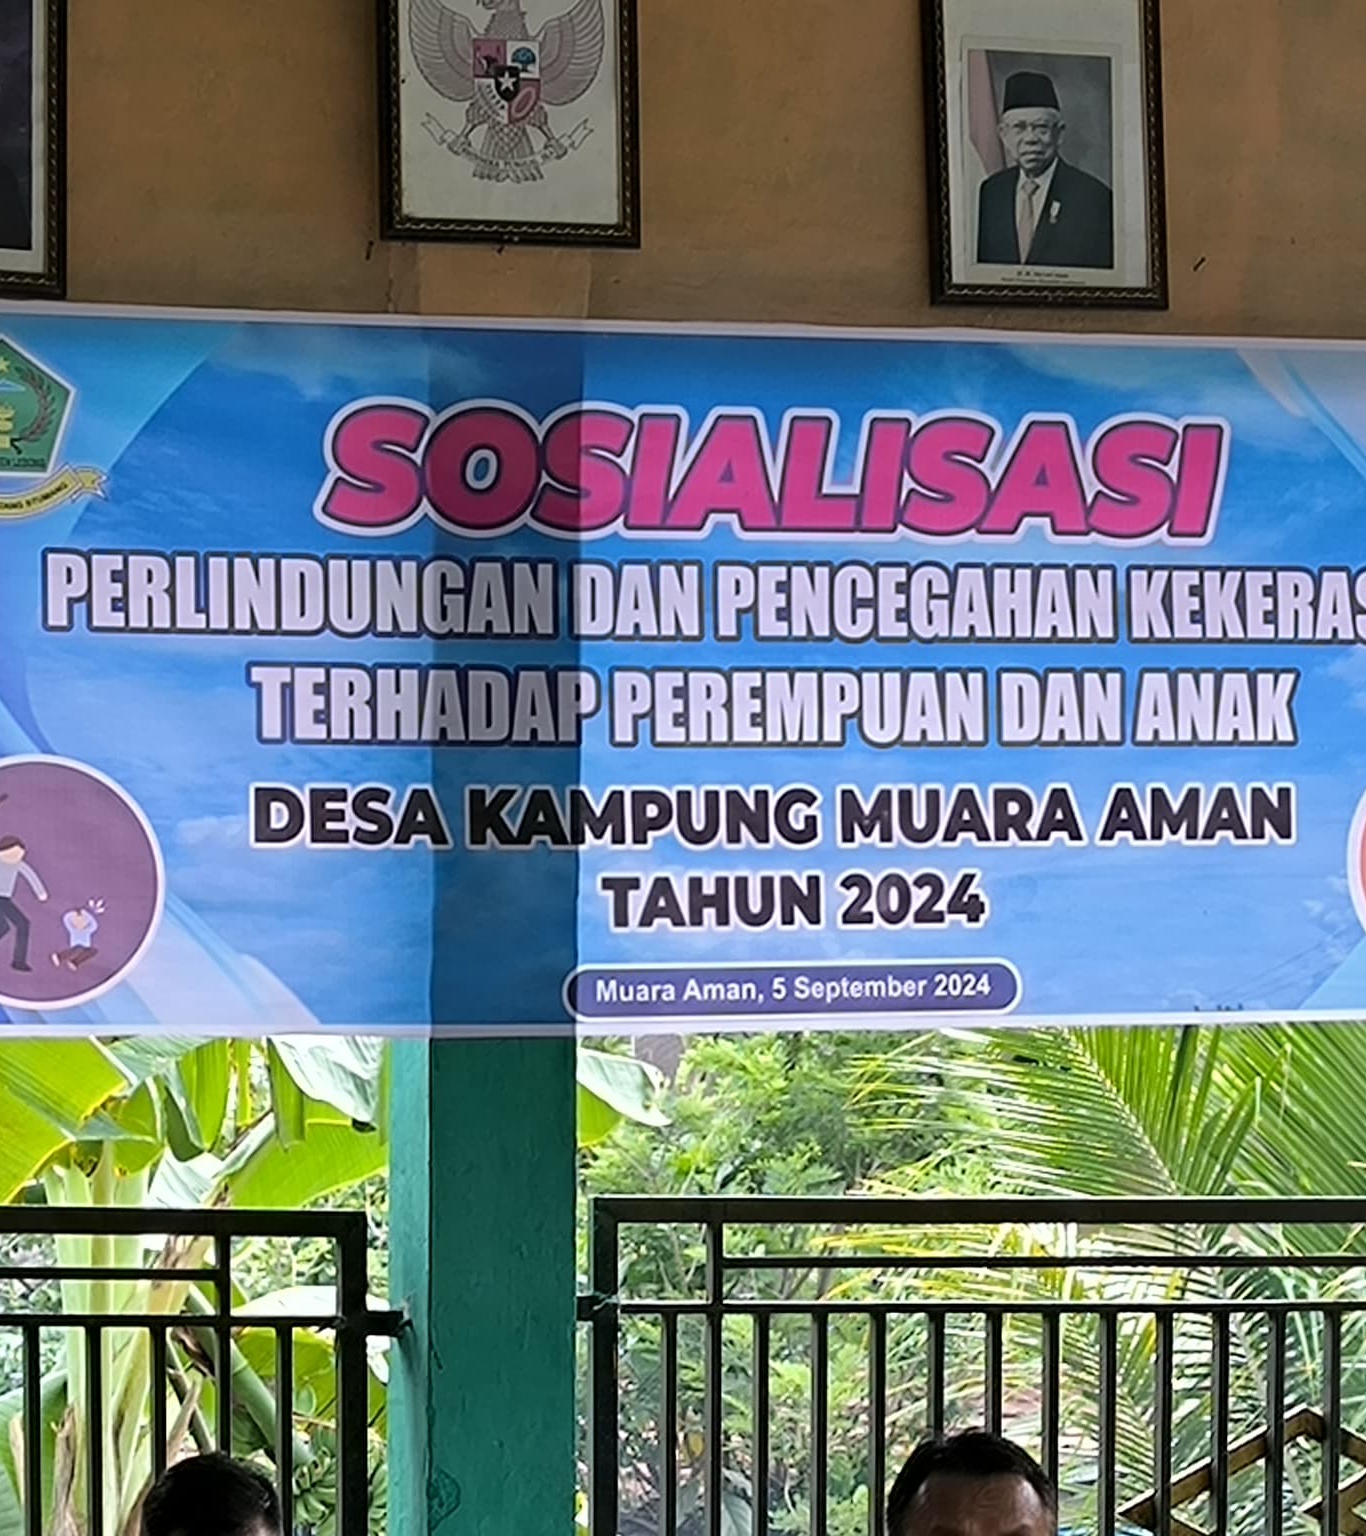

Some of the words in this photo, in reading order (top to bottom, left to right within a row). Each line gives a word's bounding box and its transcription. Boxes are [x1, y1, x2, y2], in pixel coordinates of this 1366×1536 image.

[321, 402, 1225, 540] SOSIALISASI
[44, 550, 555, 641] PERLINDUNGAN
[574, 560, 700, 641] DAN
[717, 564, 1116, 643] PENCEGAHAN
[248, 664, 602, 746] TERHADAP
[612, 668, 988, 747] PEREMPUAN
[998, 670, 1125, 747] DAN
[1135, 670, 1300, 747] ANAK
[252, 786, 450, 848] DESA
[469, 786, 821, 849] KAMPUNG
[841, 786, 1084, 846] MUARA
[1100, 785, 1295, 844] AMAN
[602, 874, 823, 931] TAHUN
[841, 872, 987, 926] 2024
[596, 978, 675, 1005] Muara
[680, 977, 766, 1009] Aman,
[772, 977, 786, 1001] 5
[793, 974, 928, 1006] September
[934, 973, 992, 999] 2024
